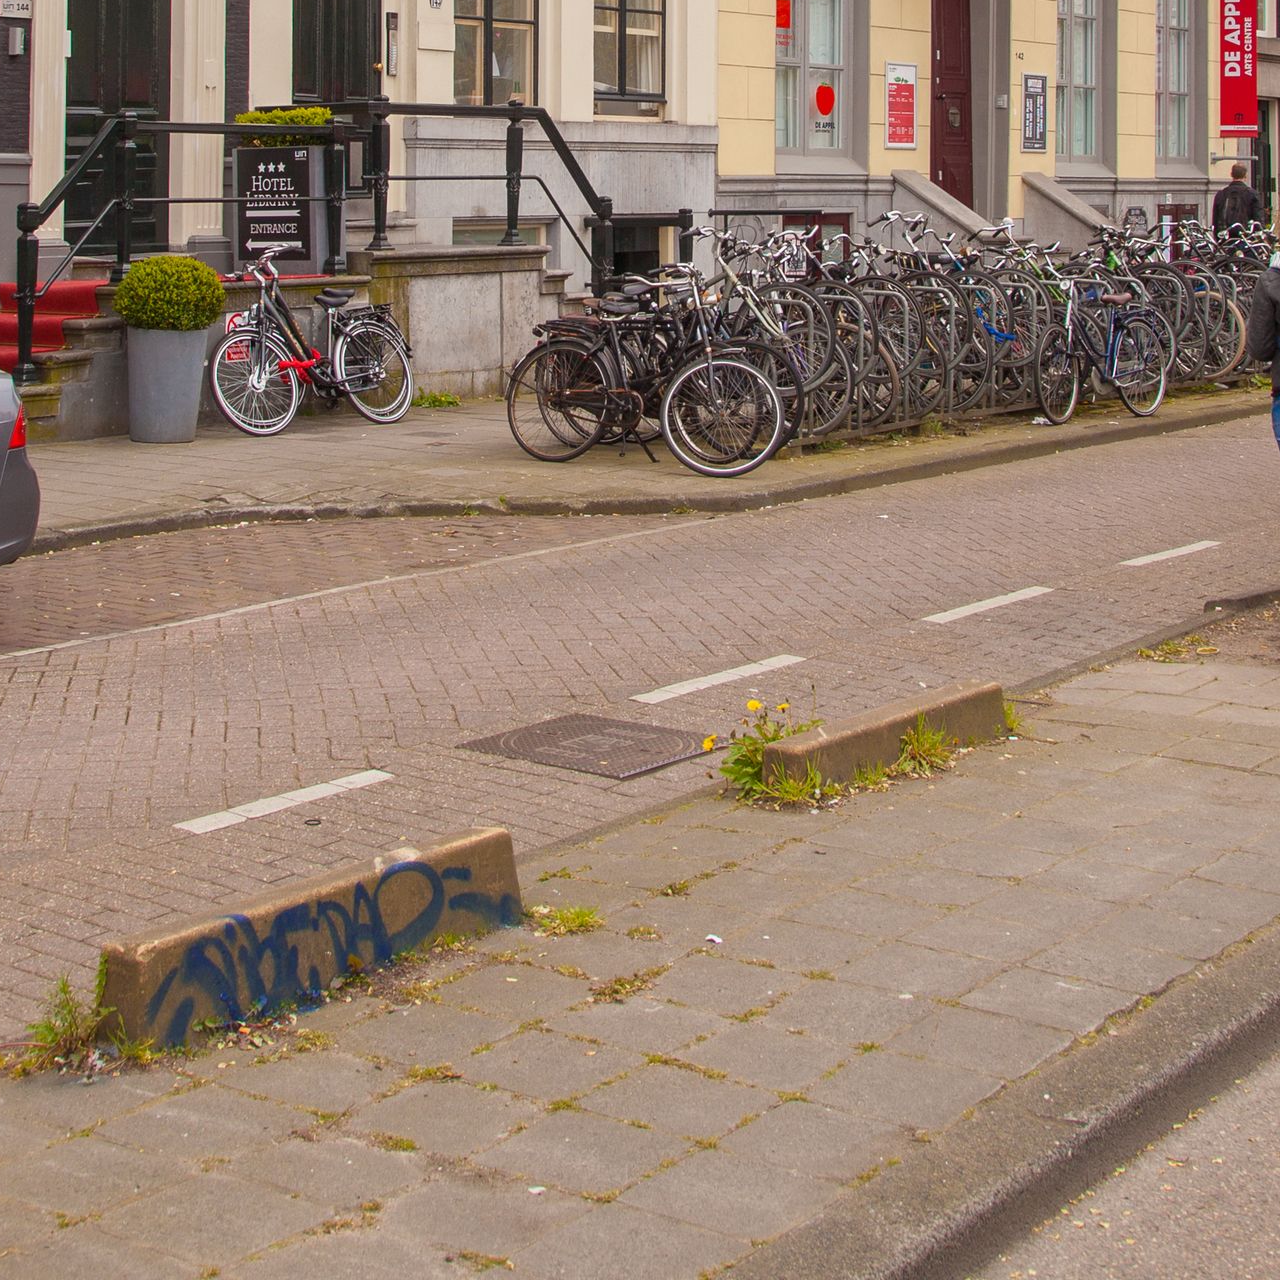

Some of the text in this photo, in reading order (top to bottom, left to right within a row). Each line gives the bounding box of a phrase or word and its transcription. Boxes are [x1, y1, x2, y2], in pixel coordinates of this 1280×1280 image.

[16, 3, 30, 11] 144
[1243, 16, 1253, 77] ARTS CENTRE
[1015, 52, 1024, 60] 142
[1224, 50, 1241, 77] DE
[251, 175, 295, 192] HOTEL
[246, 191, 300, 207] LIBRARY
[250, 223, 298, 234] ENTRANCE
